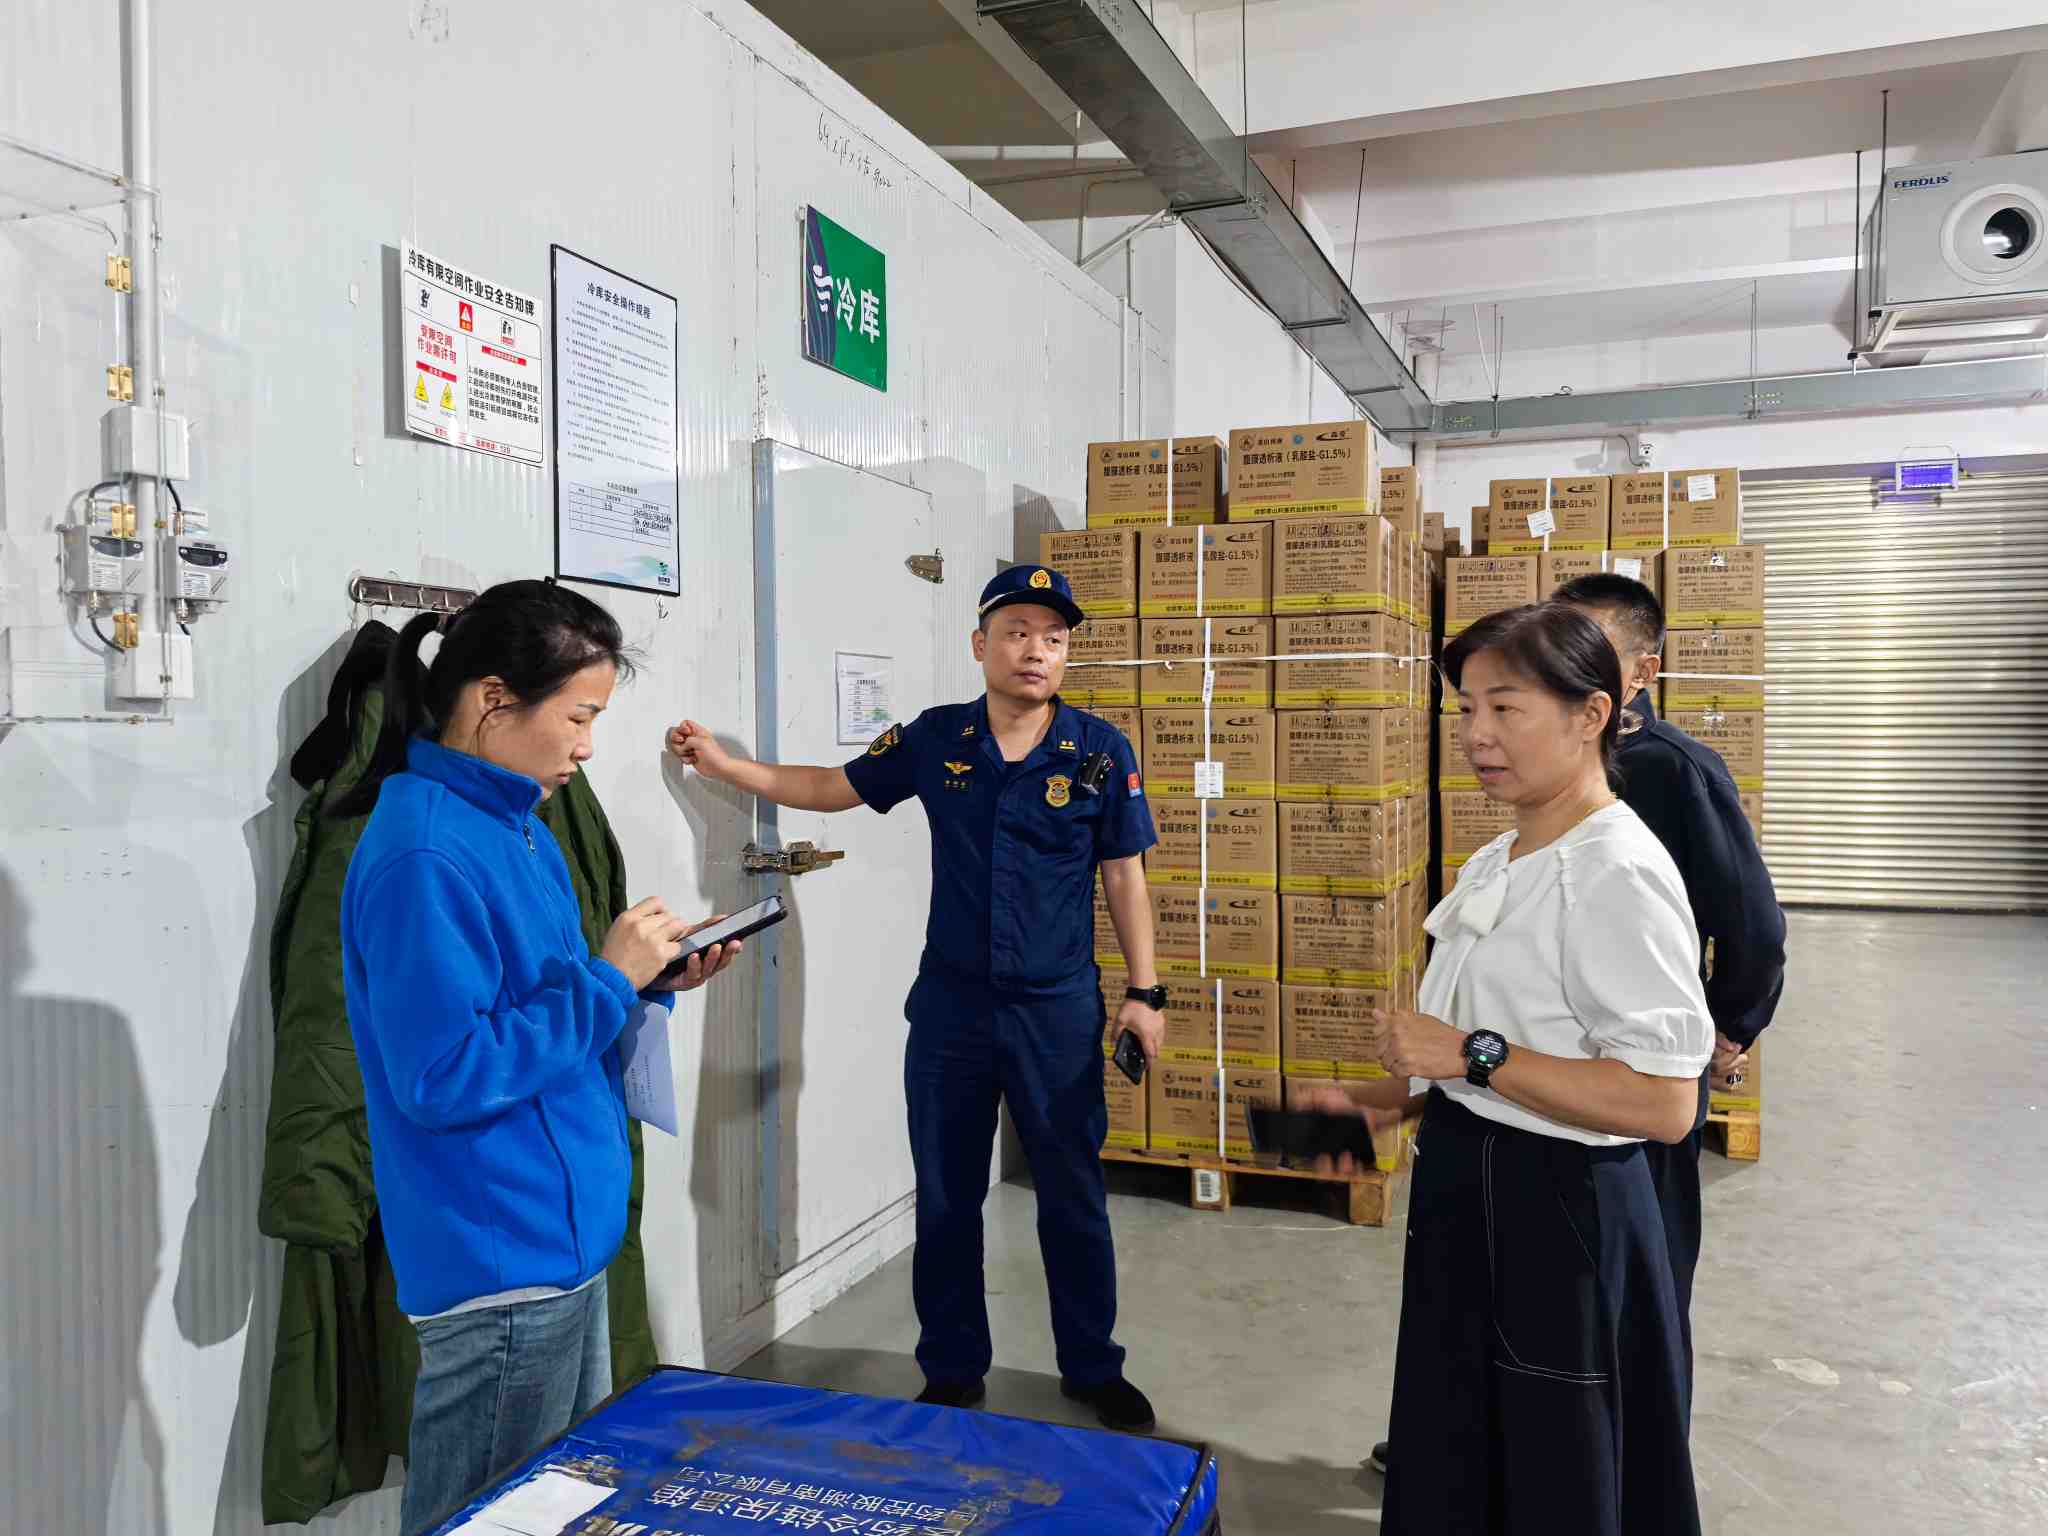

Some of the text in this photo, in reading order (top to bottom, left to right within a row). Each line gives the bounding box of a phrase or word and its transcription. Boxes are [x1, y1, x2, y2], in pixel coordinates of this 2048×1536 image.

[409, 249, 535, 316] 冷库有限空间作业安全告知牌
[588, 282, 651, 320] 冷库安全操作规程
[837, 277, 881, 344] 冷库
